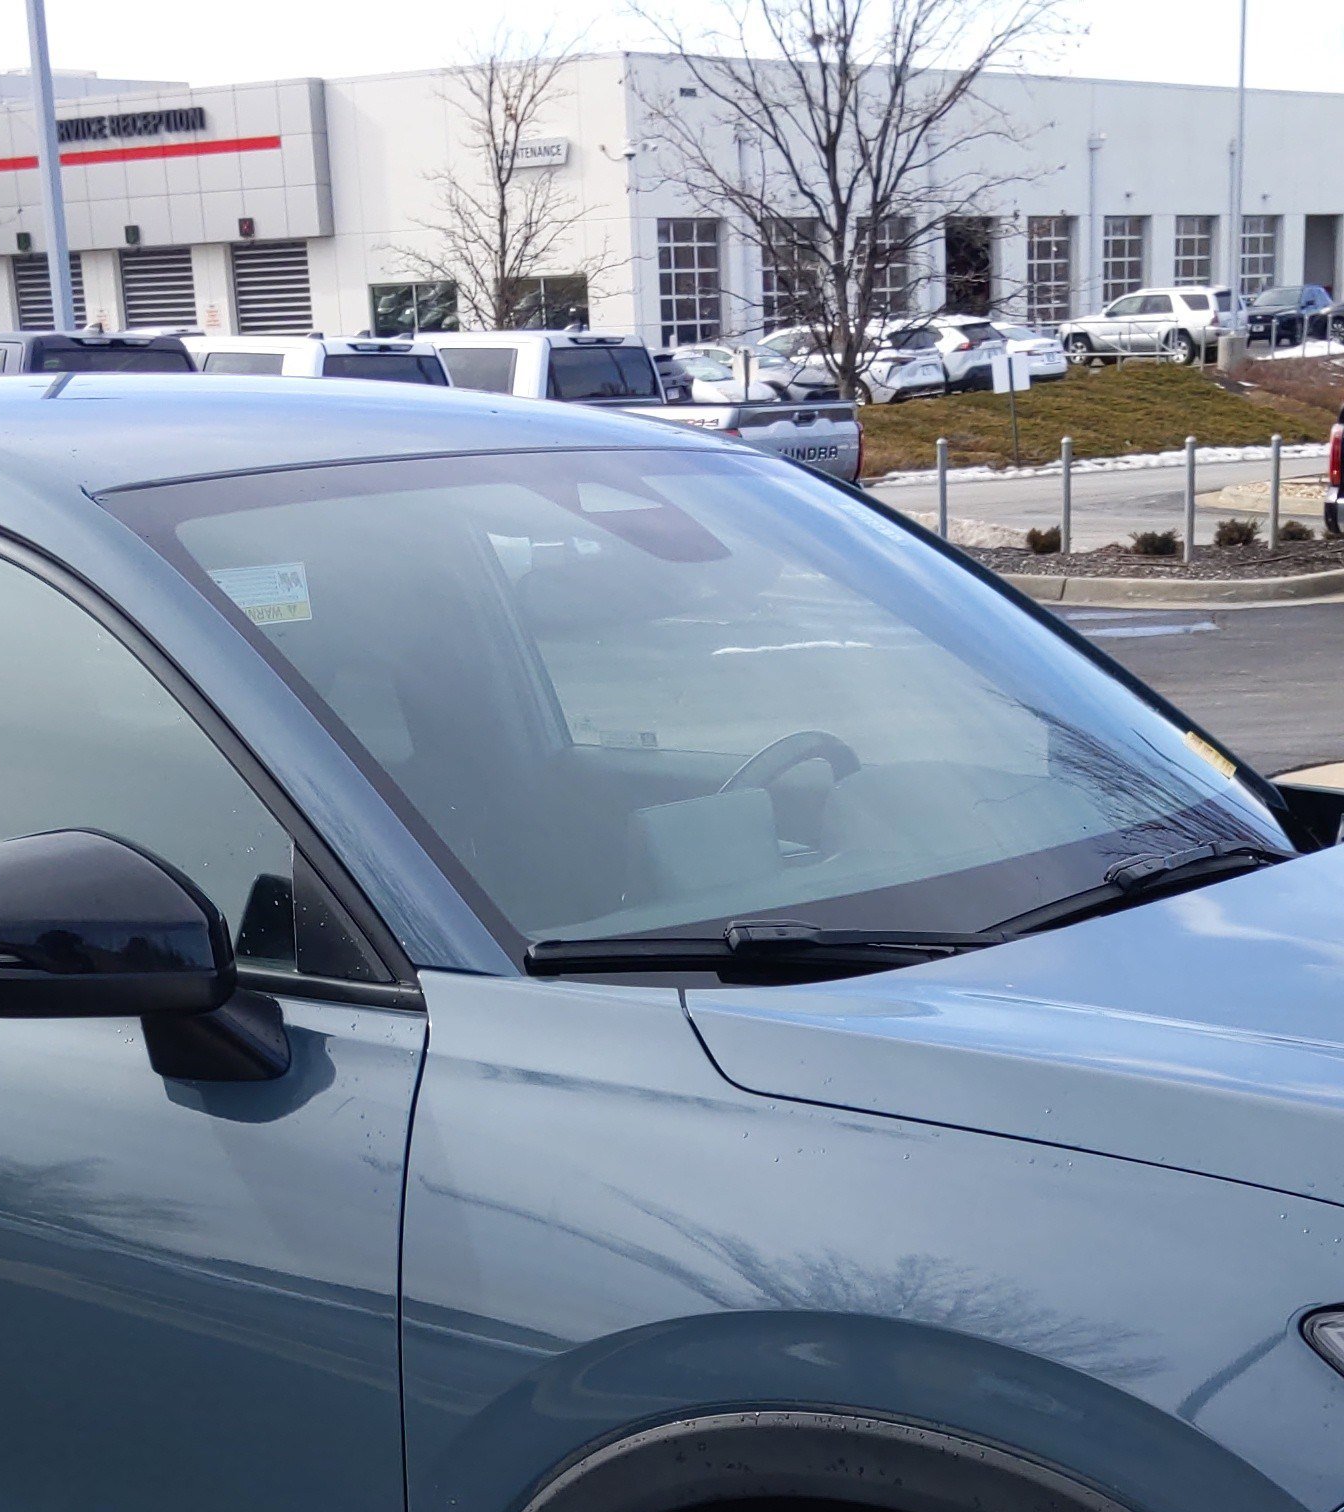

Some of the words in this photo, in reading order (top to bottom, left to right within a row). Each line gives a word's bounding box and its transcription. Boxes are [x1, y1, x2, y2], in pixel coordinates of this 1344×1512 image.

[56, 116, 108, 143] RVICE
[108, 107, 206, 138] RECEPTION
[499, 144, 562, 159] ANTENANCE
[777, 445, 839, 462] UNDRA
